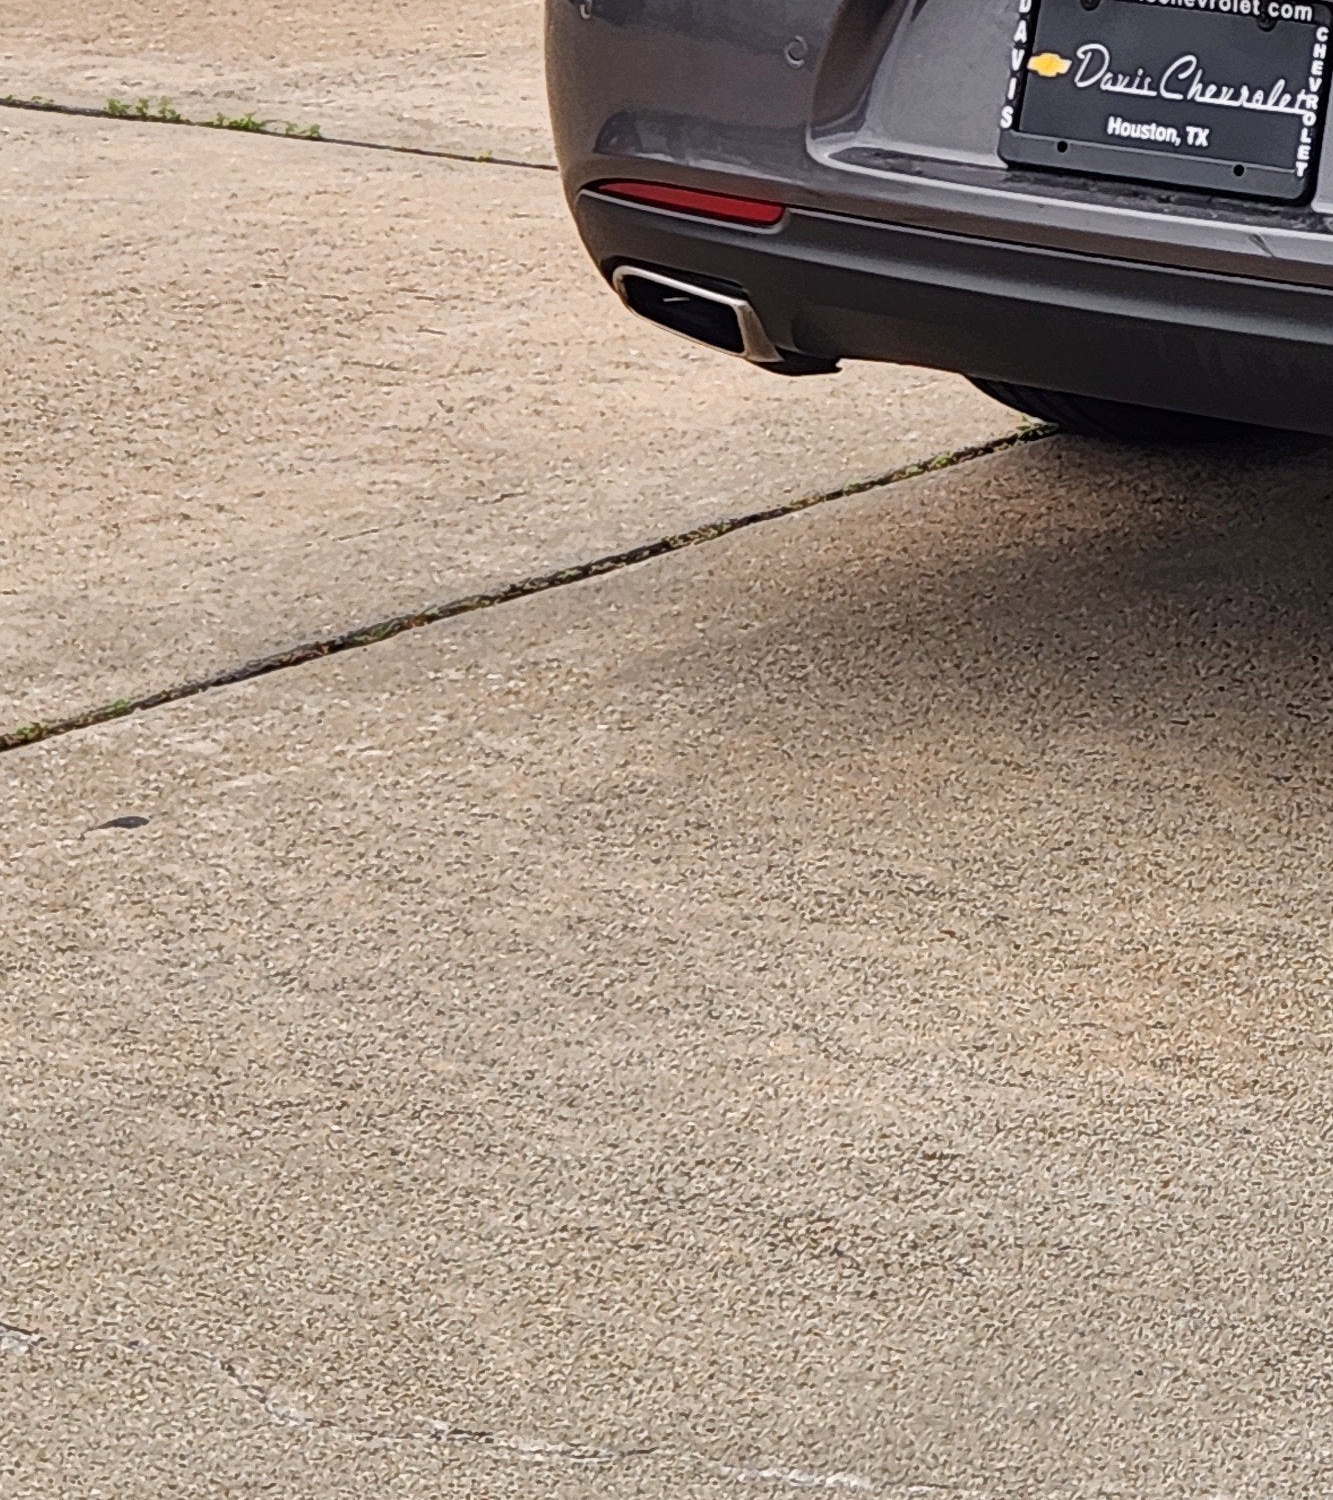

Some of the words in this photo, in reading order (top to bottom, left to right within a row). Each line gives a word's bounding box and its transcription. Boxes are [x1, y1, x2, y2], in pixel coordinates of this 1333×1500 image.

[1074, 43, 1157, 97] Davis
[1158, 54, 1309, 116] Chevrolet
[1294, 26, 1330, 177] CHEVROLET
[1106, 115, 1182, 147] Houston,
[1185, 125, 1210, 148] TX
